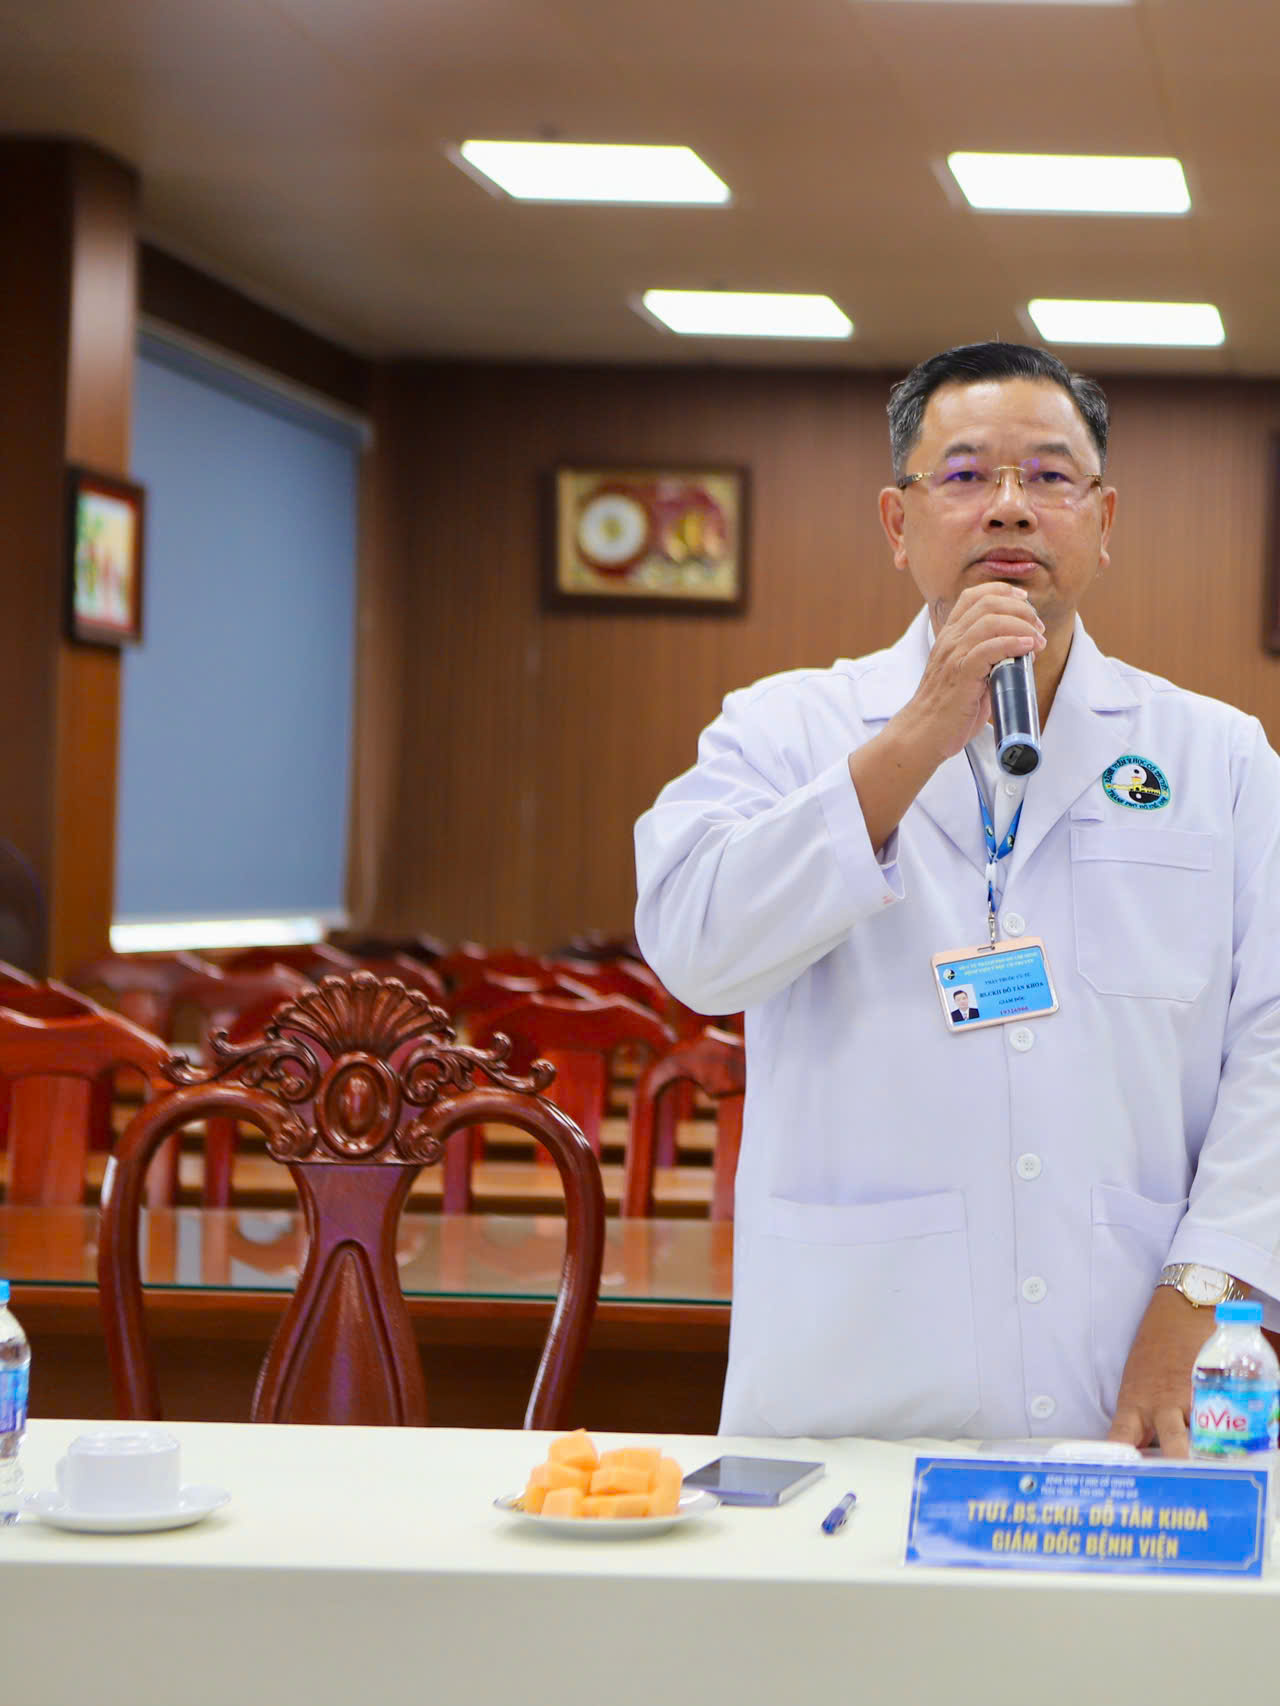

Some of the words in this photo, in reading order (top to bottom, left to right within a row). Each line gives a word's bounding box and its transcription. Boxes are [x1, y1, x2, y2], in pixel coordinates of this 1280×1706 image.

[1158, 1506, 1209, 1532] KHOA
[992, 1525, 1038, 1553] GIÁM
[1042, 1528, 1081, 1556] ĐỐC
[1085, 1528, 1134, 1560] BỆNH
[1139, 1531, 1179, 1563] VIỆN
